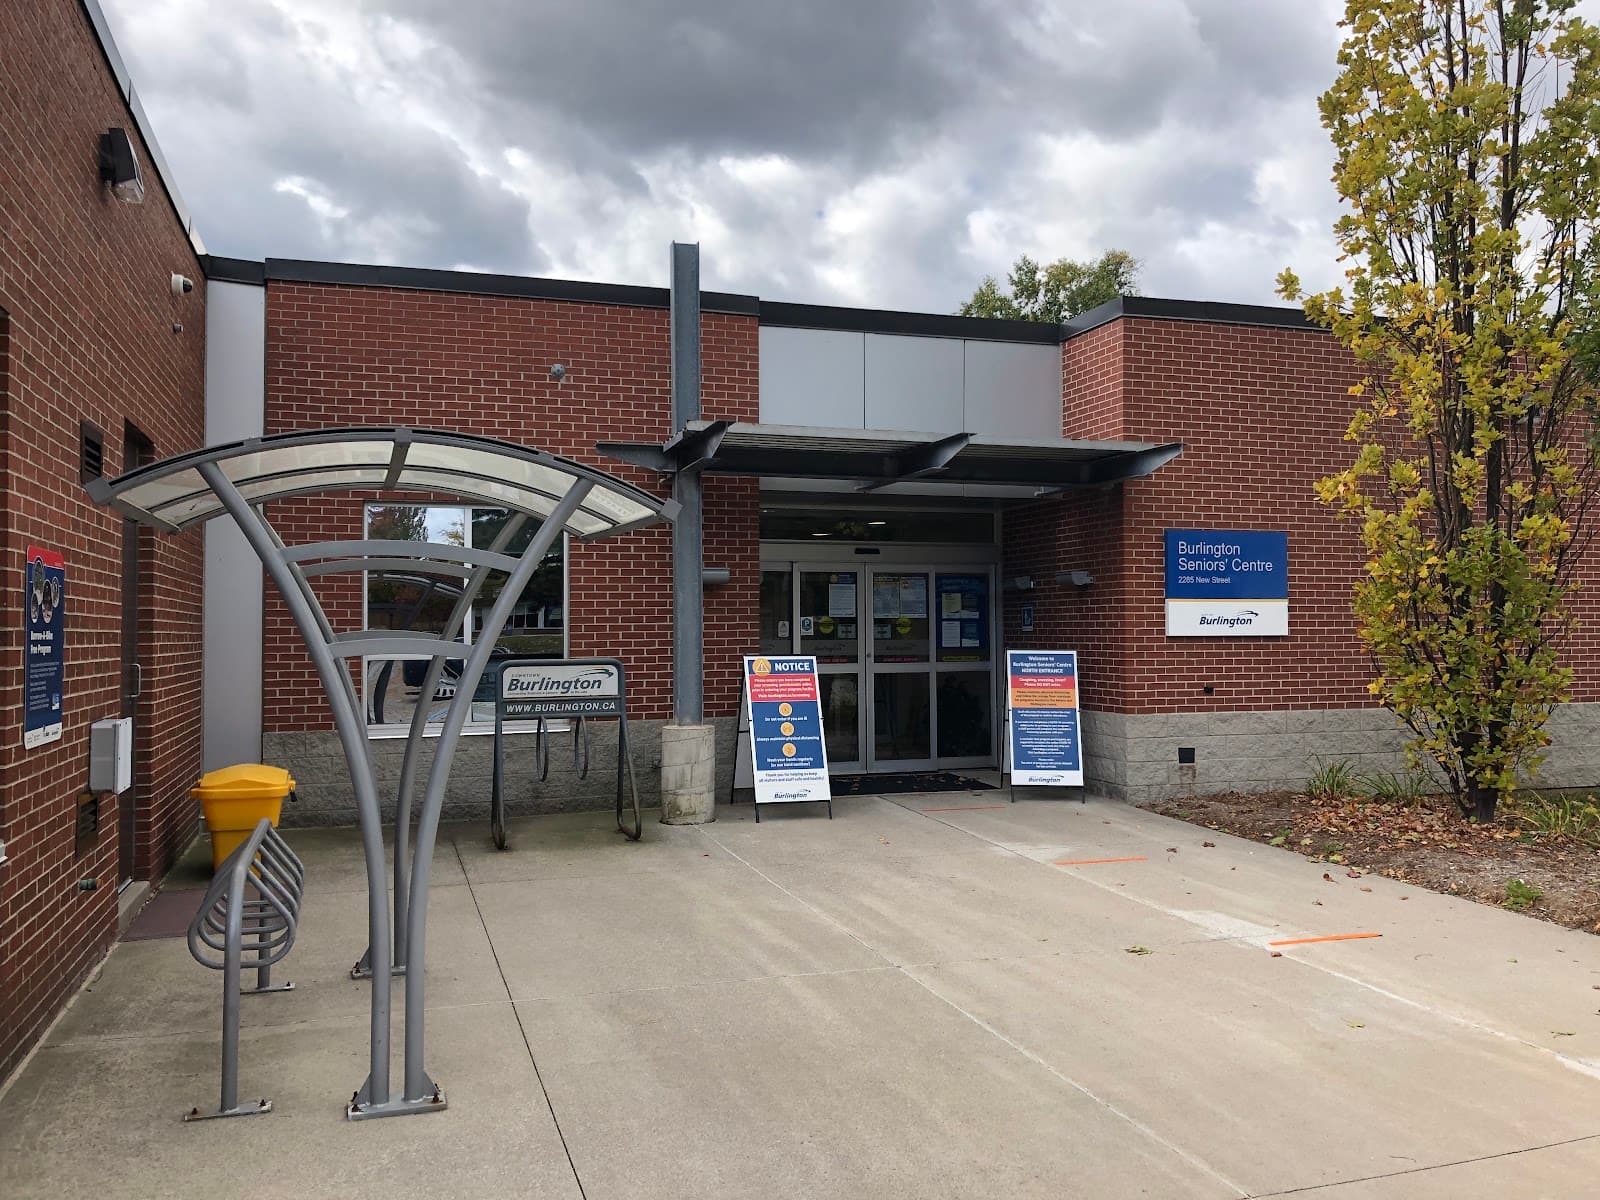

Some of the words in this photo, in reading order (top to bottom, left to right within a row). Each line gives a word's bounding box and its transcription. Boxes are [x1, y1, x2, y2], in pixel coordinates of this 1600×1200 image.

[1178, 541, 1240, 558] Burlington
[1178, 558, 1228, 571] Seniors'
[1231, 558, 1273, 572] Centre
[1178, 576, 1194, 584] 2285
[1199, 616, 1253, 628] Burlington
[38, 644, 52, 656] Program
[775, 662, 810, 671] NOTICE
[507, 677, 602, 694] Burlington
[506, 702, 616, 713] WWW.BURLINGTON.CA
